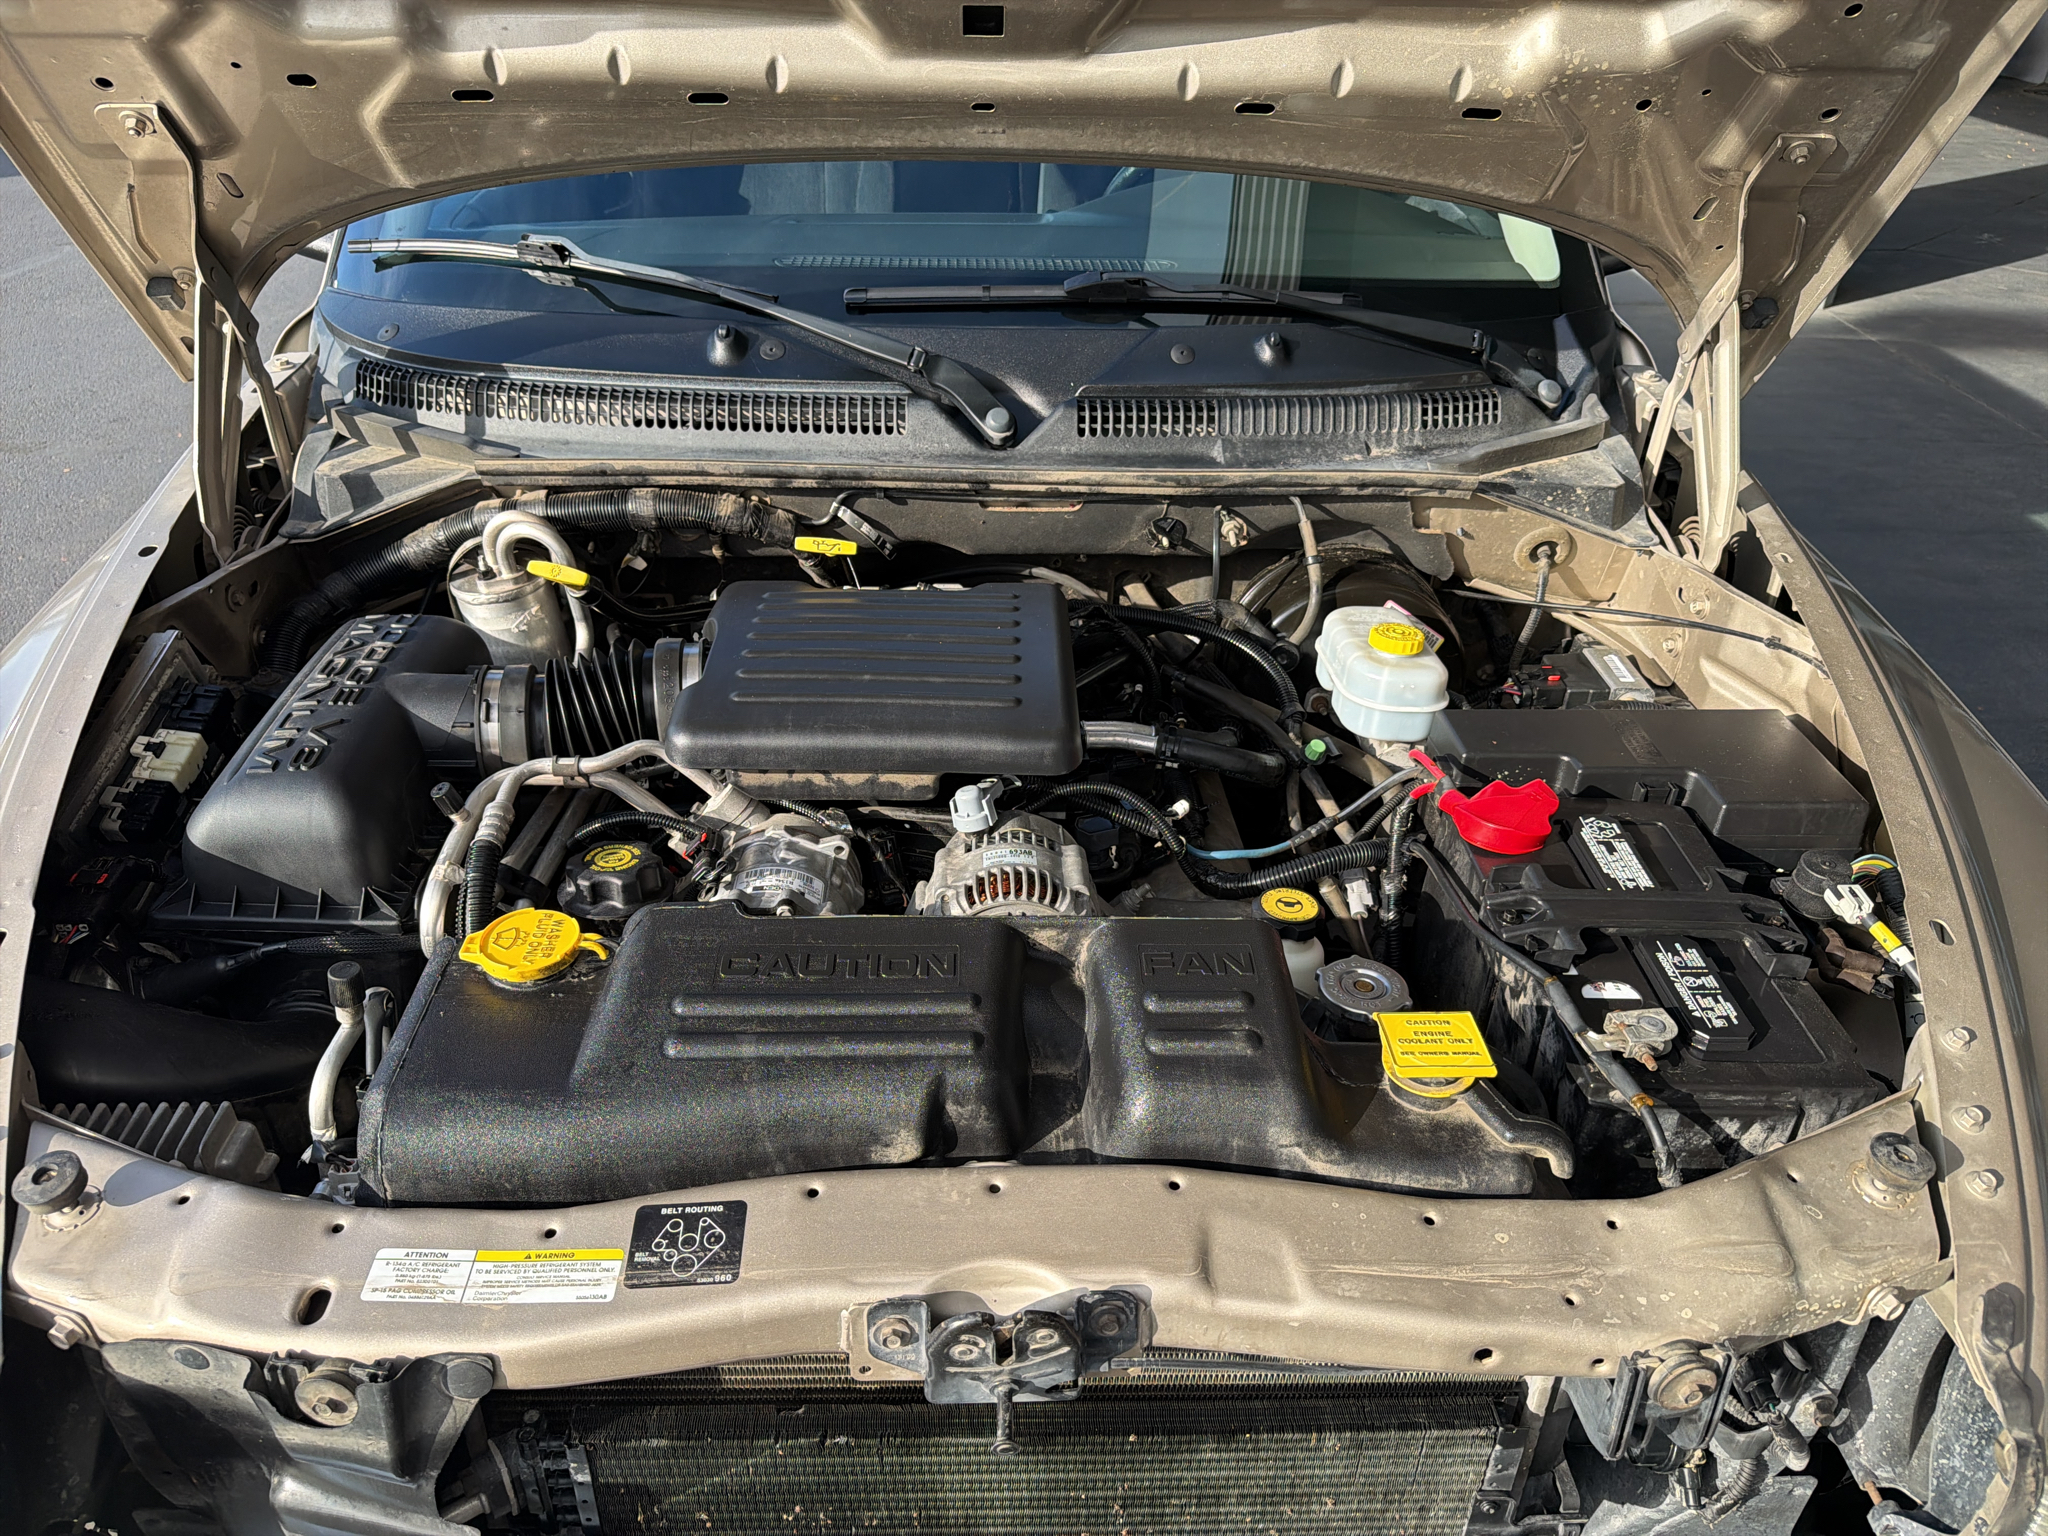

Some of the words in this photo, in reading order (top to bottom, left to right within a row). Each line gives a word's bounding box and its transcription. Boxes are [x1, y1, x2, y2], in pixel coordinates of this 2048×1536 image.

[327, 614, 422, 707] DODGE
[246, 613, 391, 774] MAGNUM
[287, 718, 346, 772] V8
[532, 913, 554, 938] FLUID
[540, 919, 566, 959] WASHER
[522, 941, 542, 964] ONLY
[720, 950, 957, 980] CAUTION
[1143, 950, 1256, 976] FAN
[1655, 952, 1676, 977] POISON
[1674, 982, 1697, 1010] DANGER
[685, 1205, 724, 1213] ROUTING
